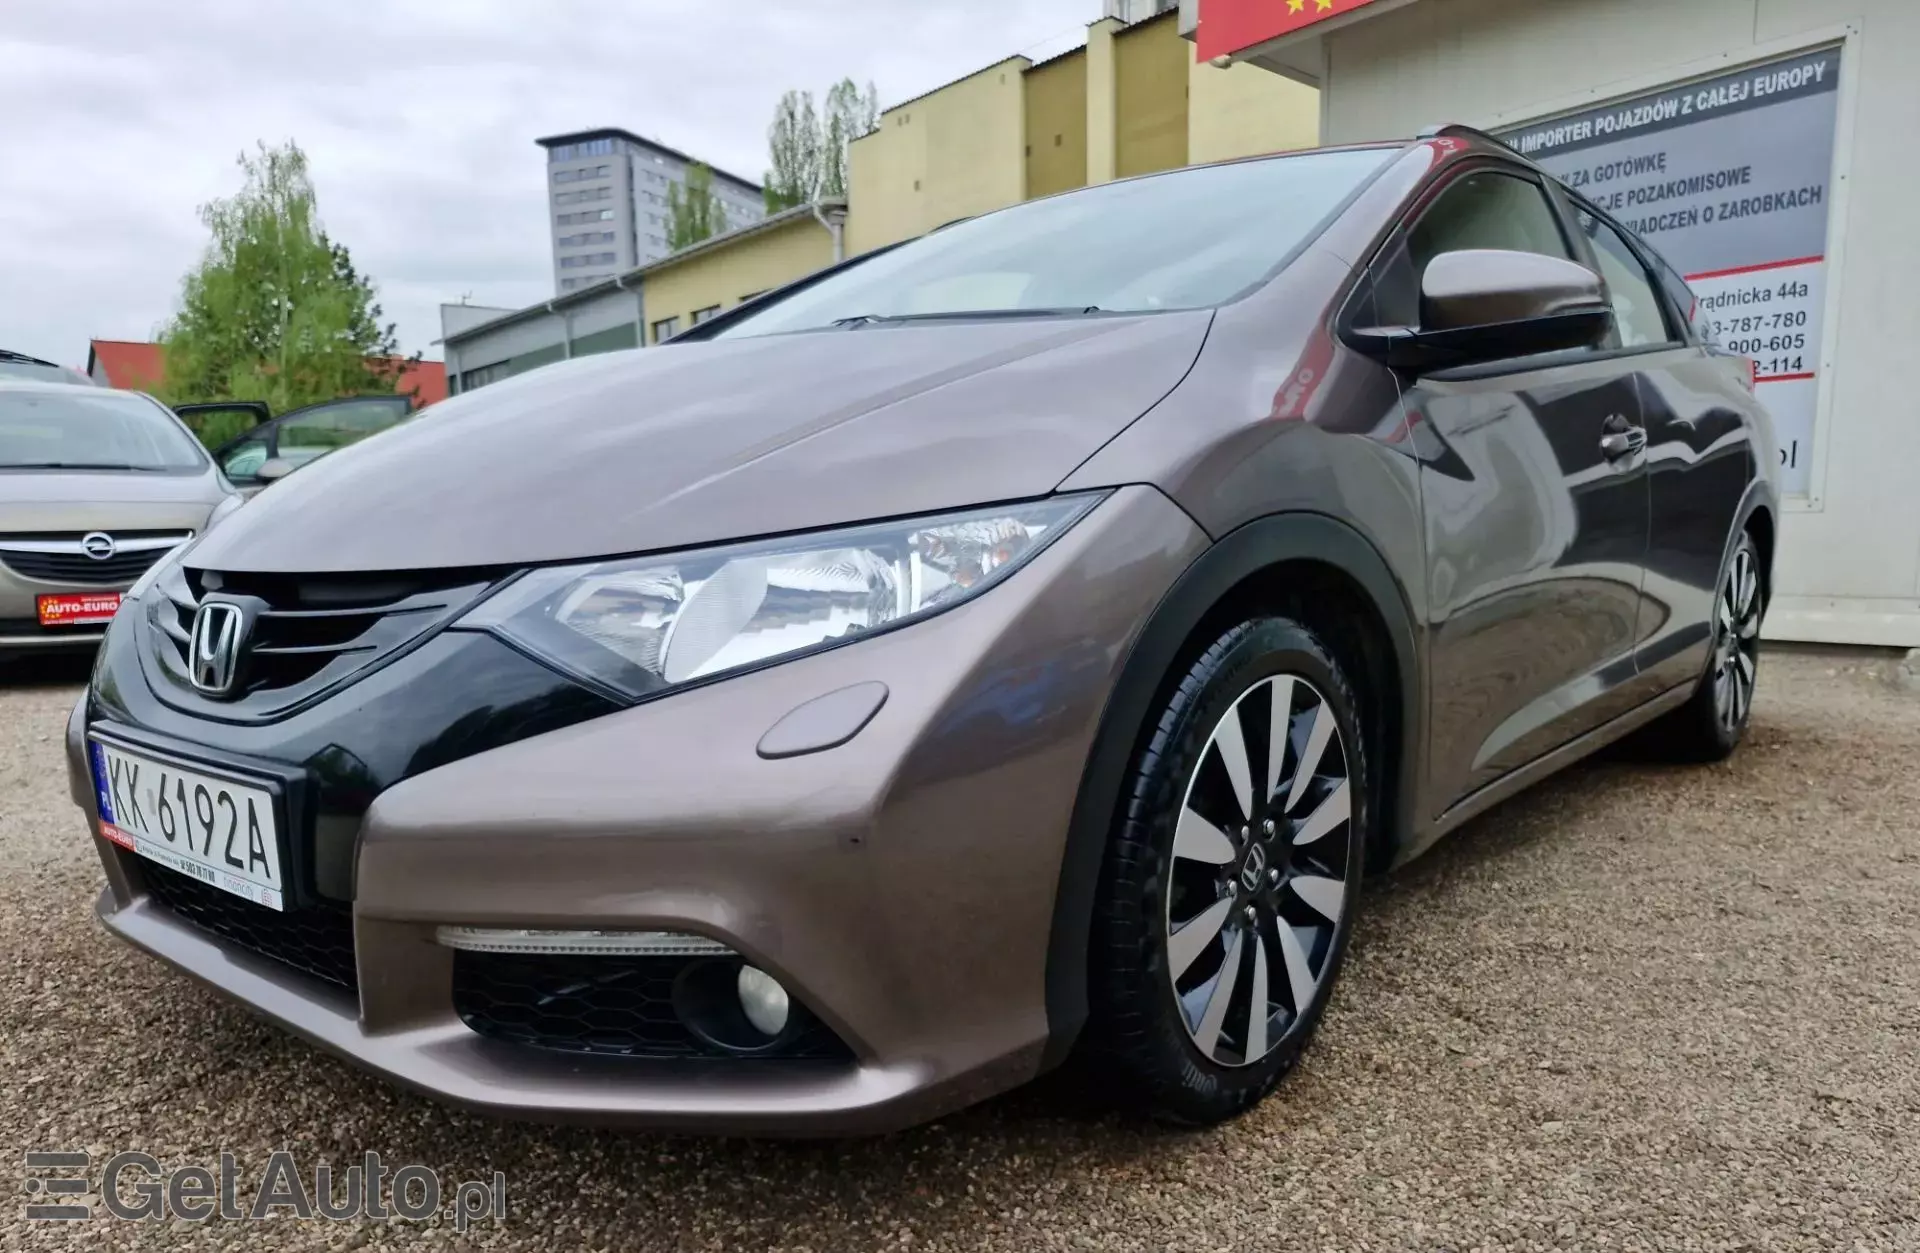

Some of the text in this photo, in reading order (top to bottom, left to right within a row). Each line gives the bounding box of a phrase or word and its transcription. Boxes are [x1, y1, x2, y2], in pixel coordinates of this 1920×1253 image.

[1520, 121, 1592, 154] IMPORTER
[1594, 97, 1678, 137] POJAZDÓW
[1681, 94, 1692, 115] Z
[1696, 81, 1750, 111] CAŁEJ
[1753, 60, 1828, 98] EUROPY
[1571, 170, 1590, 188] ZA
[1594, 152, 1667, 183] GOTÓWKĘ
[1626, 166, 1752, 206] POZAKOMISOWE
[1702, 205, 1714, 224] O
[1718, 185, 1822, 221] ZAROBKACH
[1697, 281, 1809, 313] rądnicka 44a
[46, 601, 118, 614] AUTO-EURO
[107, 753, 271, 881] KK 6192A
